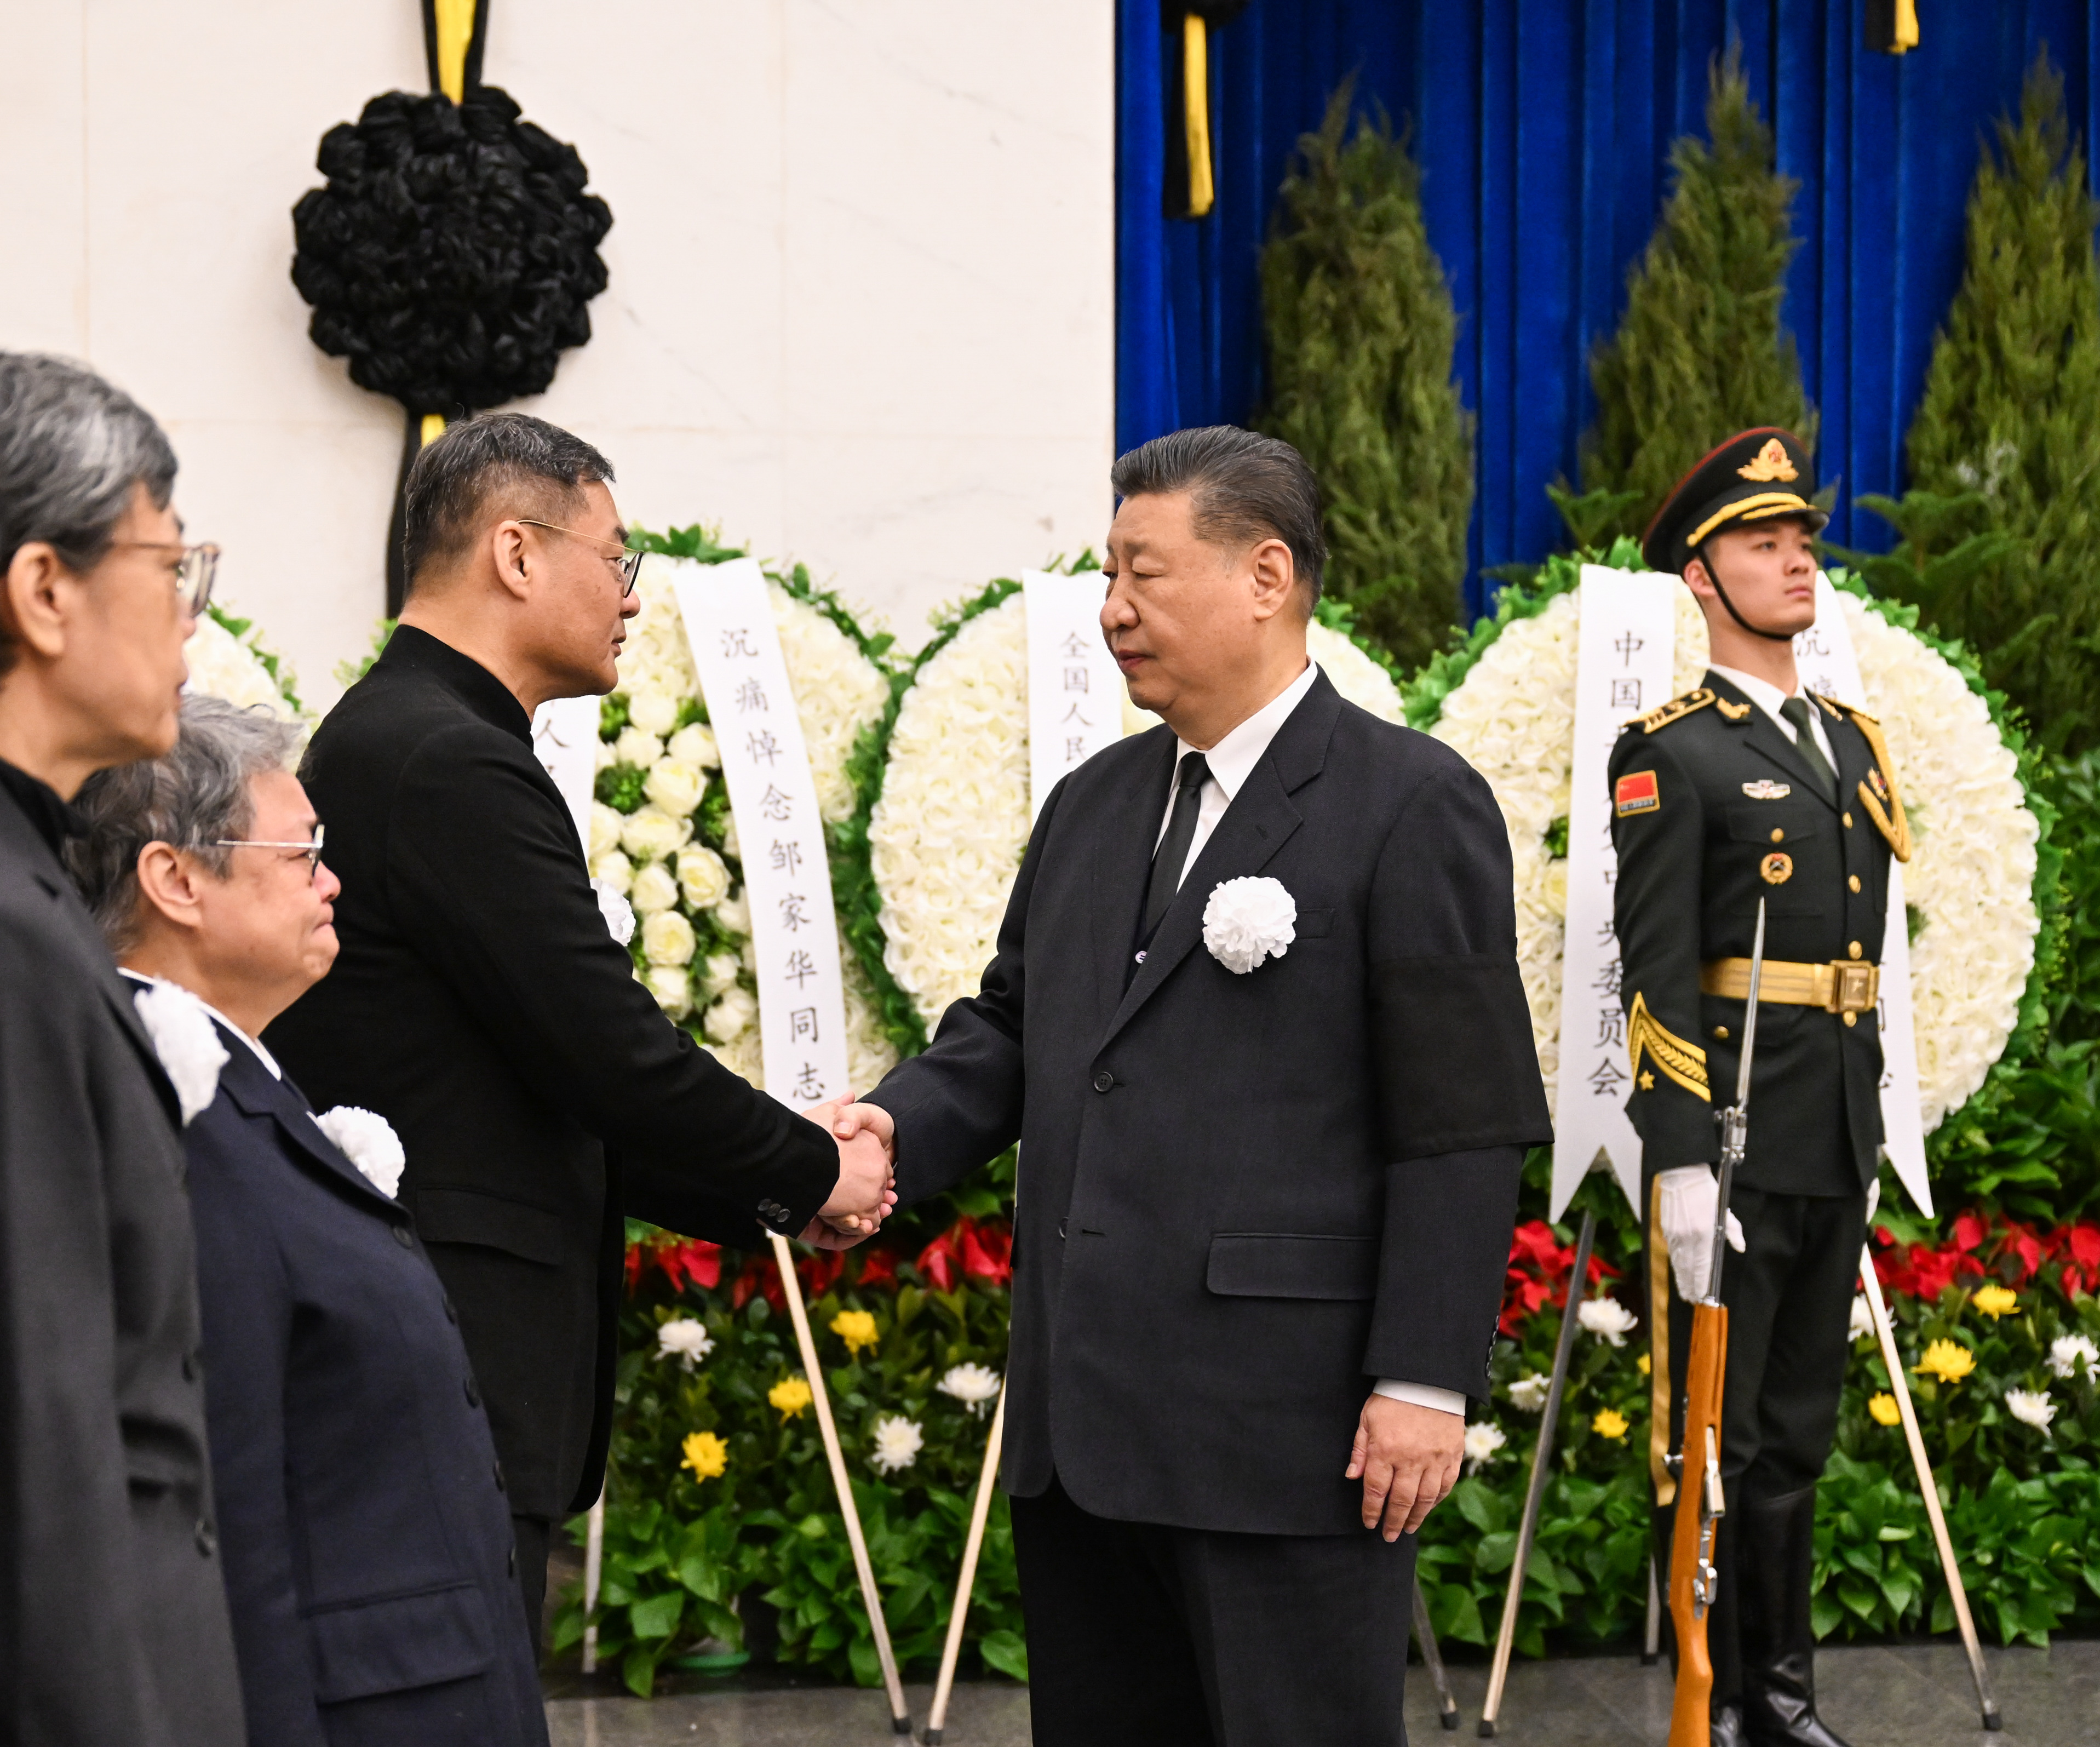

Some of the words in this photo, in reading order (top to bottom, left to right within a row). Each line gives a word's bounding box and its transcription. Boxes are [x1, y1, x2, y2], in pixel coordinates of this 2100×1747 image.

[1060, 631, 1094, 761] 全国人民
[720, 628, 825, 1101] 沉痛悼念邹家华同志
